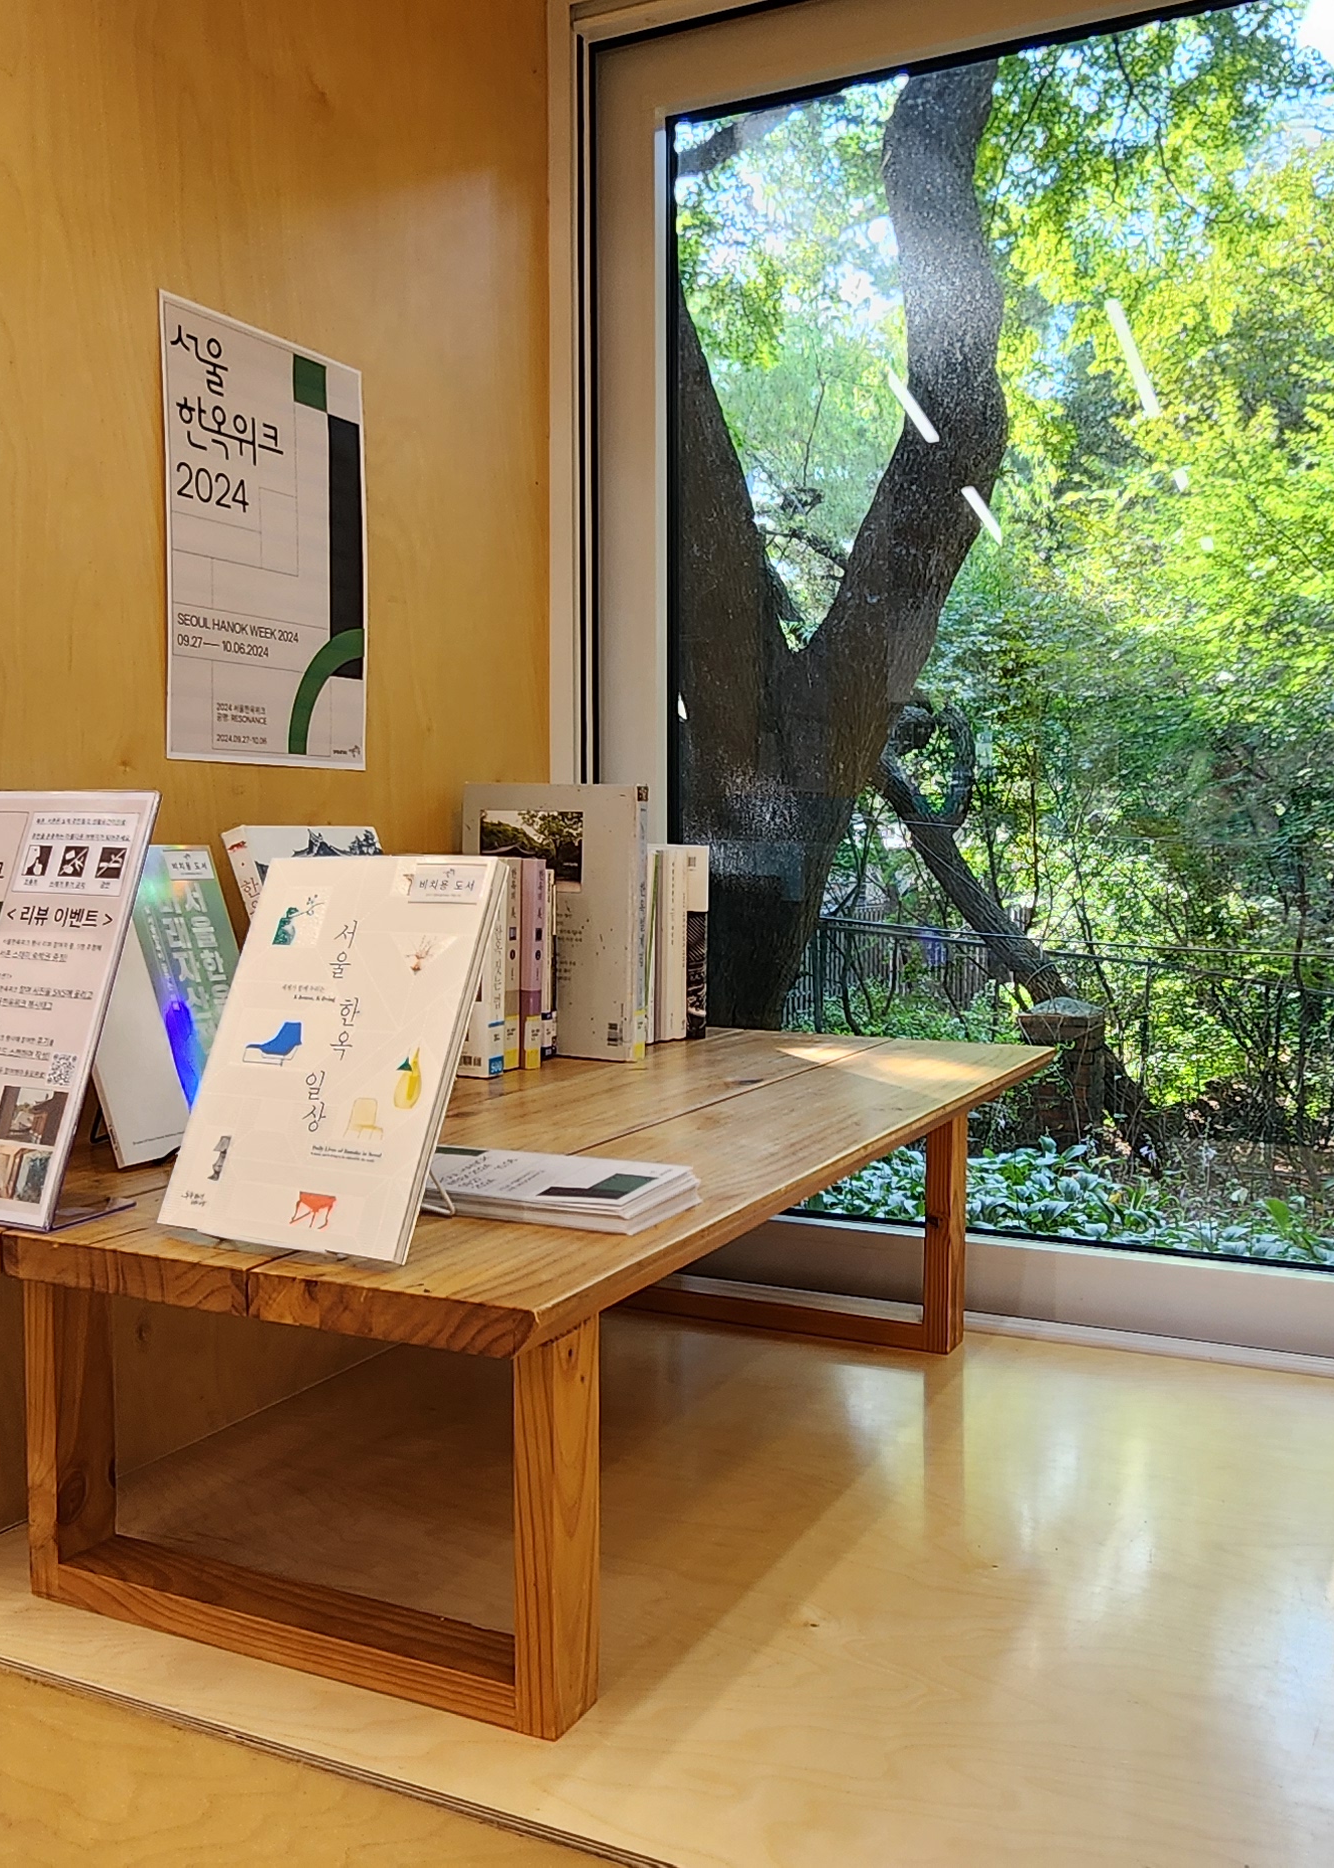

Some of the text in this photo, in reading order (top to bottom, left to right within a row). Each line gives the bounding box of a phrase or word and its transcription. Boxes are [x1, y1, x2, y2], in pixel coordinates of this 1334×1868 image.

[170, 324, 229, 397] 서울
[175, 396, 284, 466] 한옥위크
[175, 461, 250, 513] 2024
[177, 612, 299, 644] SEOUL HANOK WEEK 2024
[177, 633, 203, 649] 09.27
[222, 640, 269, 658] 10.06.2024
[418, 878, 476, 892] 비치용 도서
[19, 905, 49, 926] 리뷰
[53, 907, 99, 928] 이벤트
[328, 919, 359, 980] 서울
[329, 996, 361, 1061] 한옥
[301, 1070, 327, 1133] 일상
